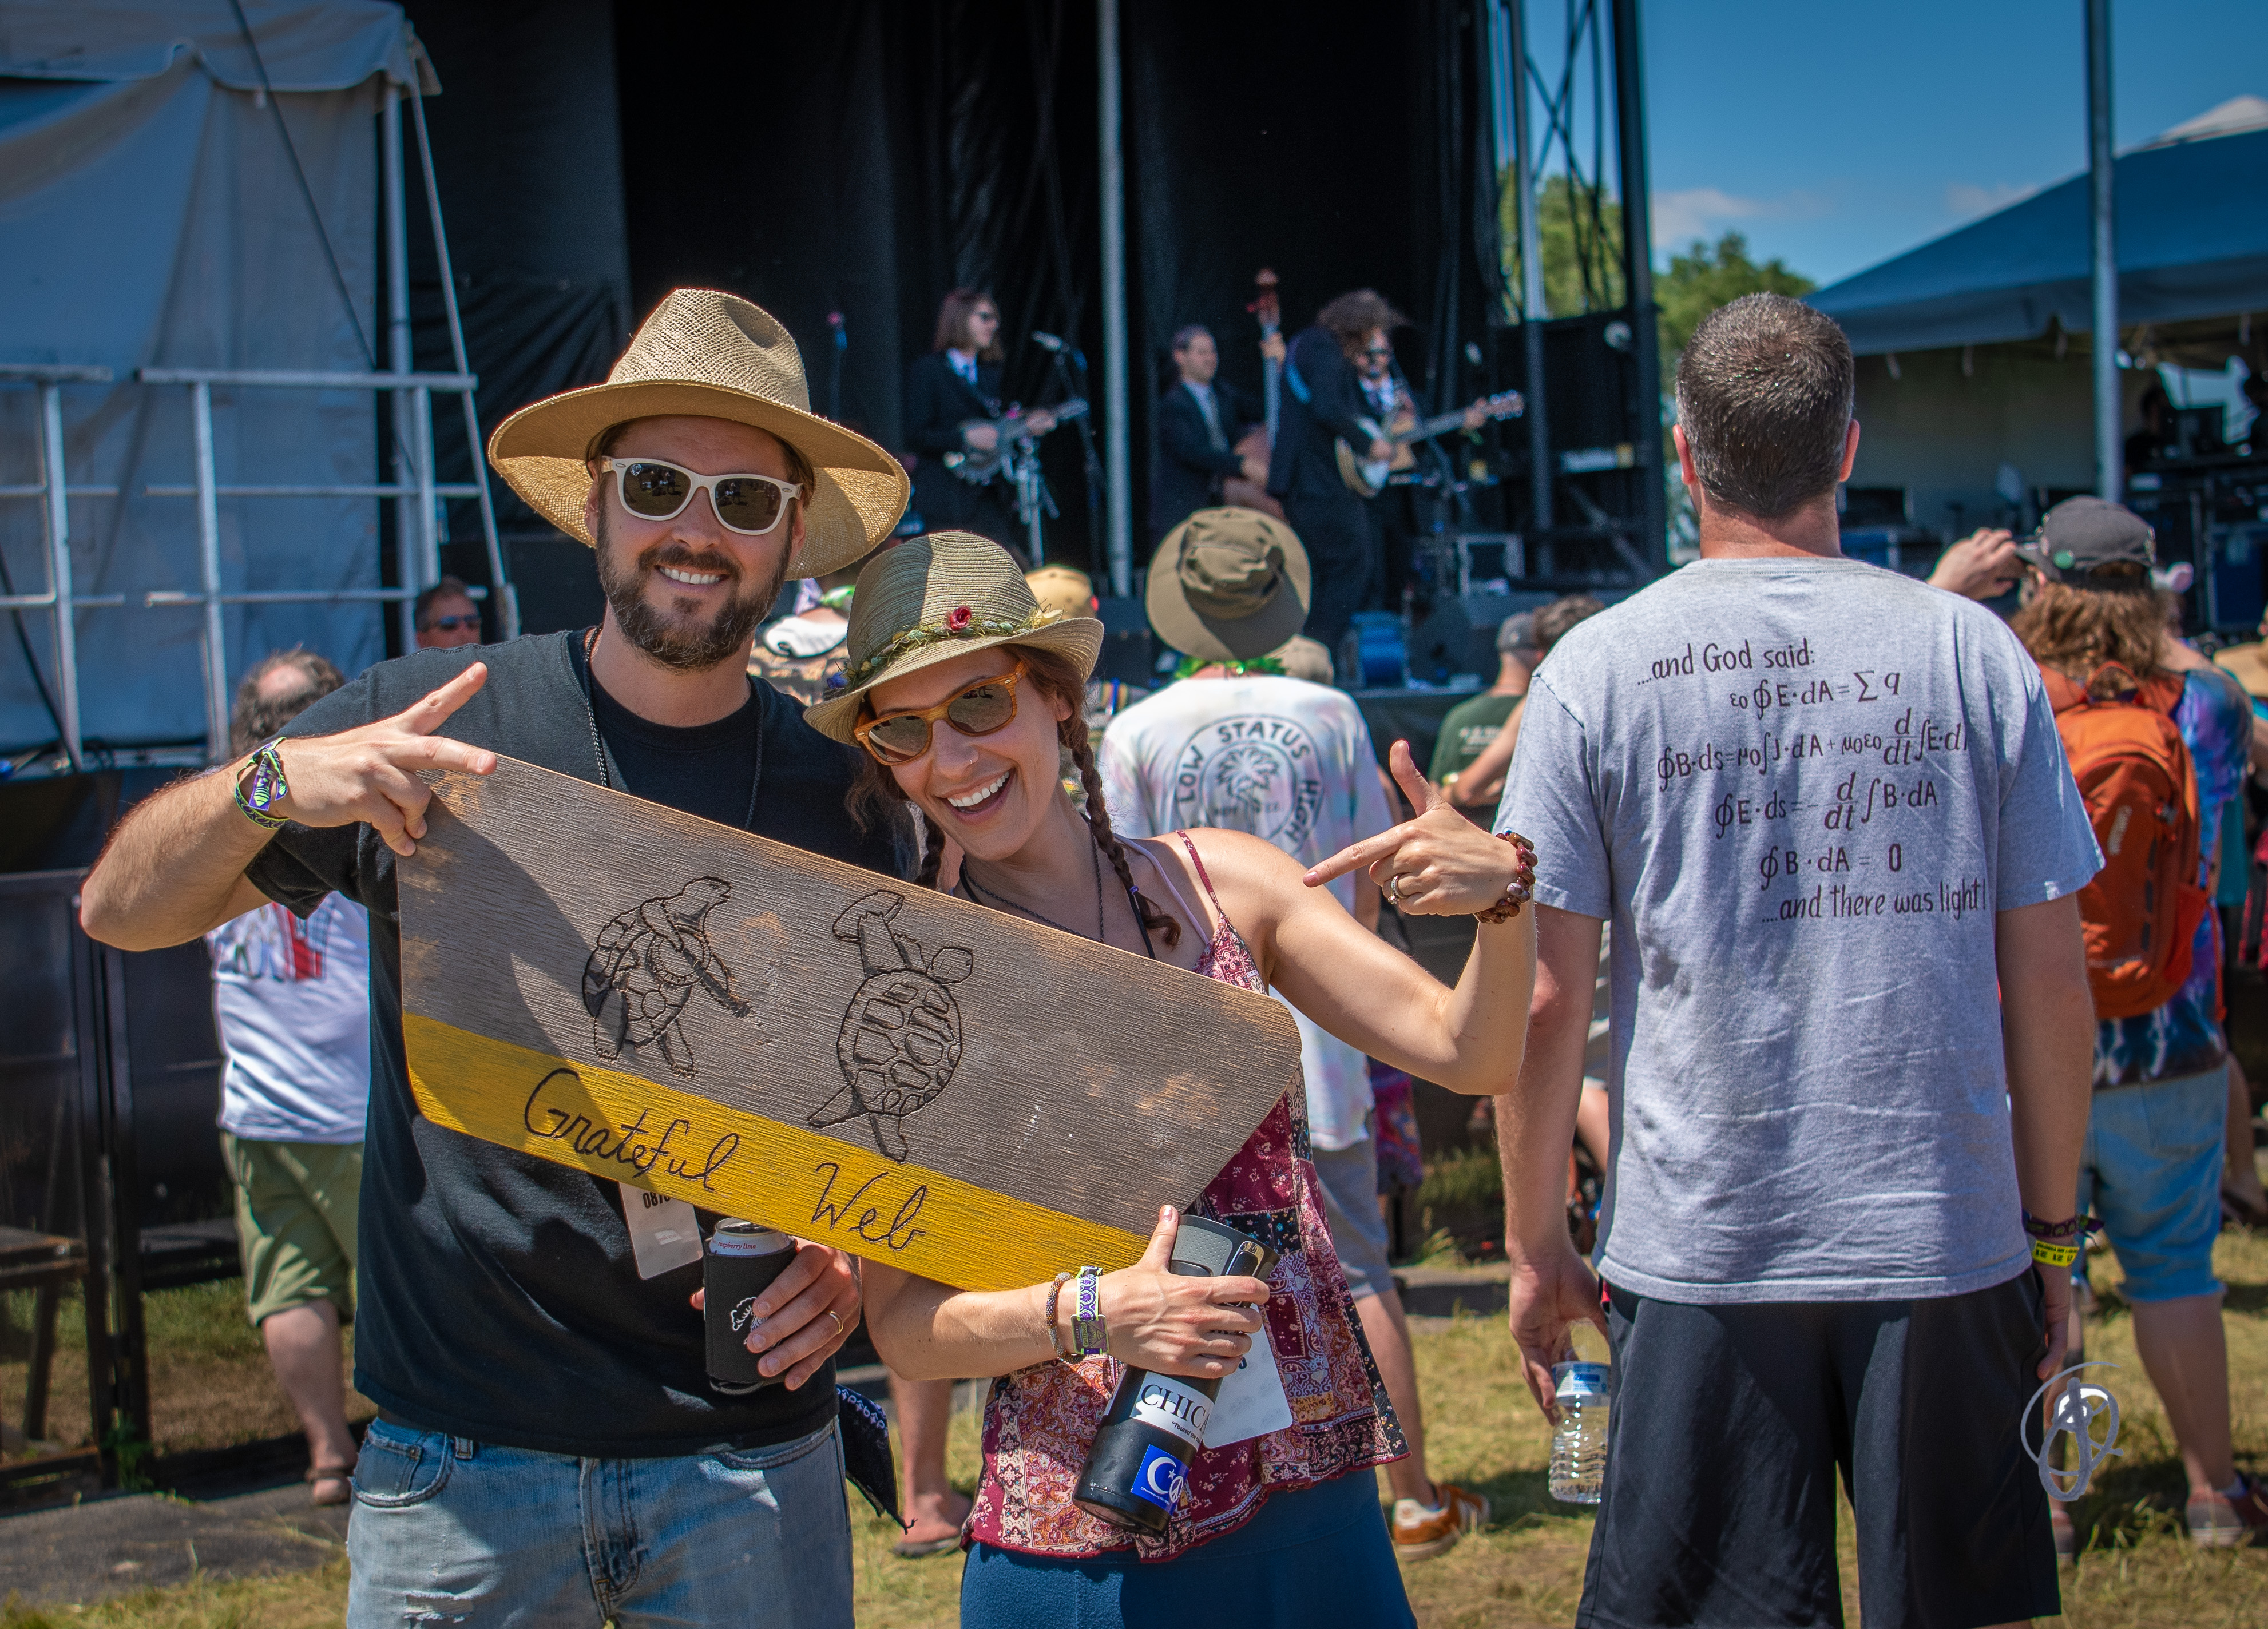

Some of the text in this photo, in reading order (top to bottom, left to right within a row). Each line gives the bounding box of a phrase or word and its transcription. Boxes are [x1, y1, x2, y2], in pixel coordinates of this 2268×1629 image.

[1703, 638, 1753, 672] God
[1763, 636, 1816, 669] said:
[1179, 721, 1319, 844] LOW STATUS HIGH
[1830, 884, 1886, 917] there
[1894, 892, 1934, 914] was
[1939, 877, 1987, 921] light!
[524, 1067, 929, 1253] Grateful Web
[717, 1241, 742, 1251] raspberry
